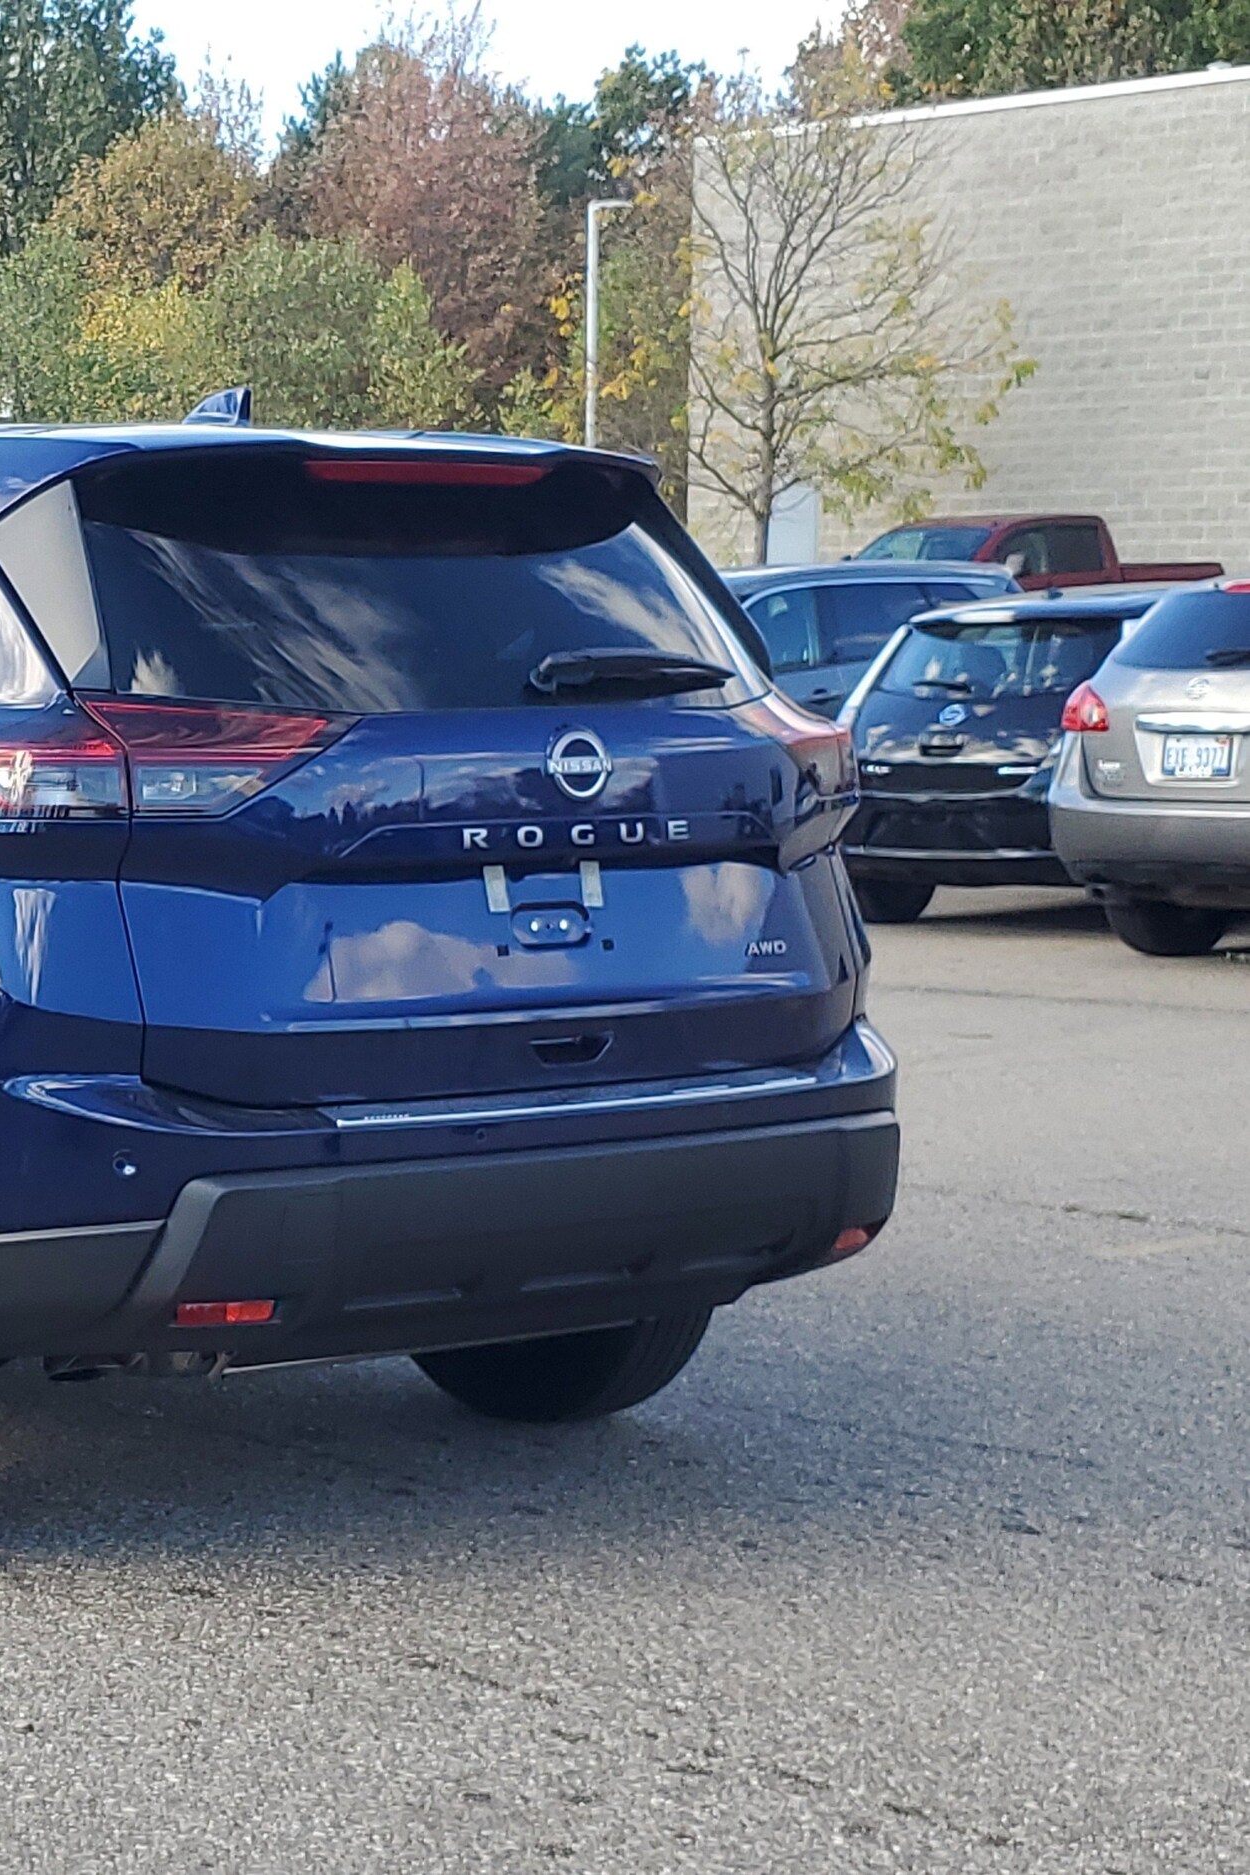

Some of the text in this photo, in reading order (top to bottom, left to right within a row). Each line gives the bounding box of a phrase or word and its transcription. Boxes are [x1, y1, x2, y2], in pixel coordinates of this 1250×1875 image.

[549, 760, 612, 774] NISSAN
[462, 820, 690, 850] ROGUE
[747, 940, 787, 956] AWD
